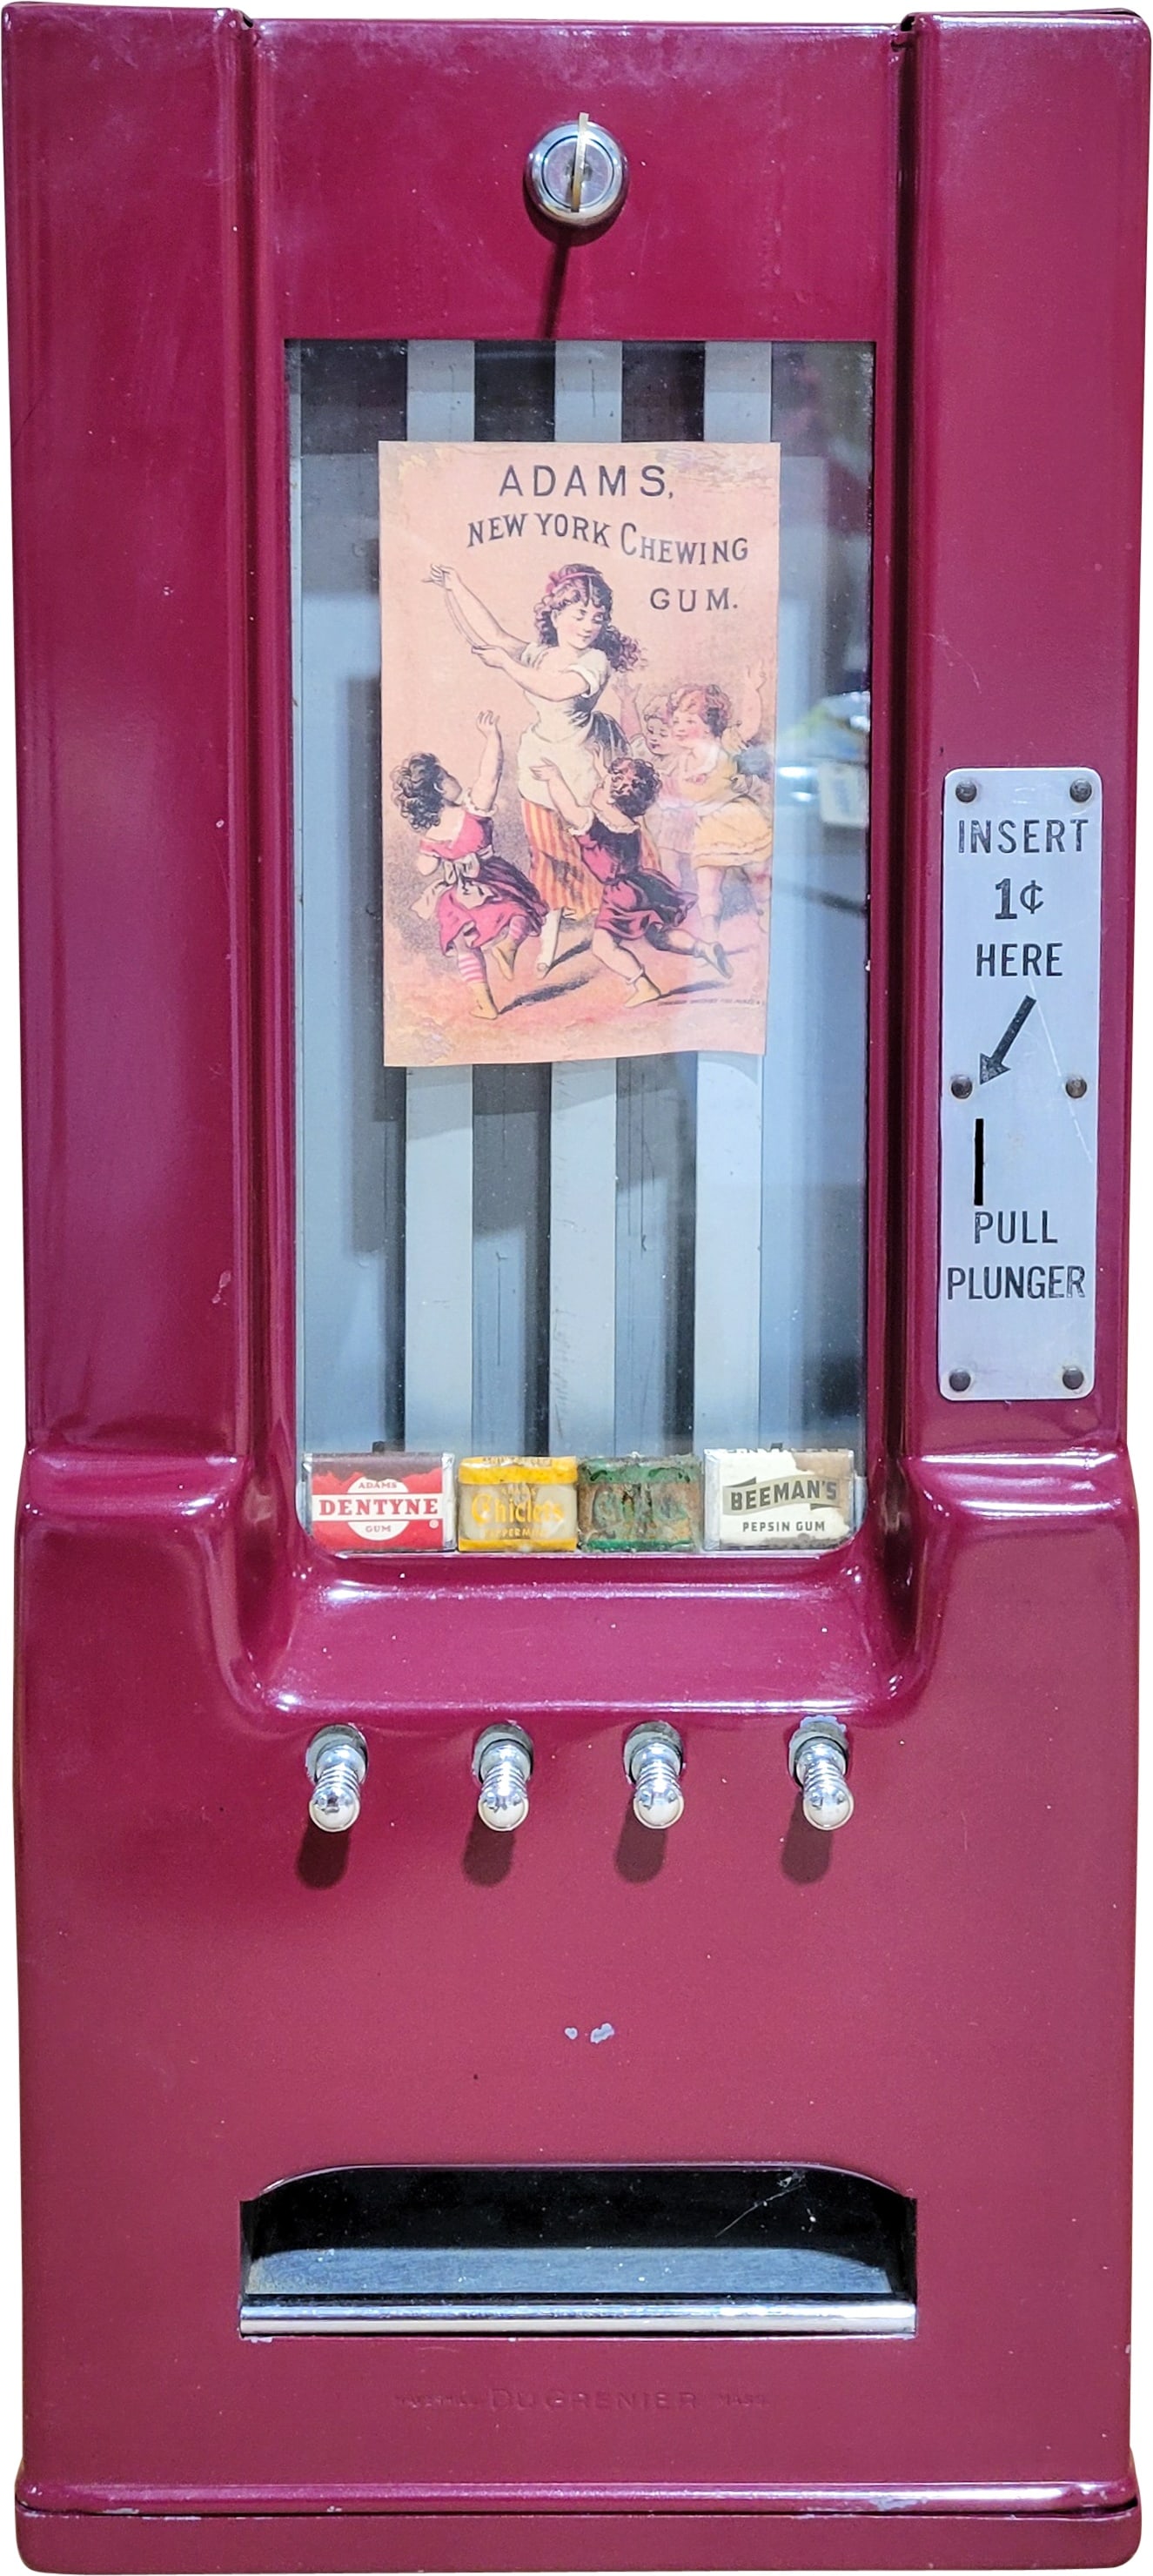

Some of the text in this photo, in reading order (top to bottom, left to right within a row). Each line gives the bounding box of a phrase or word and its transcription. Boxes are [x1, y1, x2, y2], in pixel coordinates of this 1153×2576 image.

[499, 464, 674, 500] ADAMS,
[466, 513, 749, 566] NEW YORK CHEWING
[649, 587, 739, 613] GUM.
[957, 818, 1089, 855] INSERT
[994, 877, 1045, 921] 1¢
[975, 943, 1063, 977] HERE
[974, 1210, 1059, 1244] PULL
[947, 1265, 1086, 1300] PLUNGER
[318, 1498, 439, 1516] DENTYNE
[471, 1493, 564, 1528] Chiclets
[730, 1479, 838, 1512] BEEMAN'S
[365, 1525, 392, 1533] GUM
[742, 1520, 826, 1533] PEPSIN GUM
